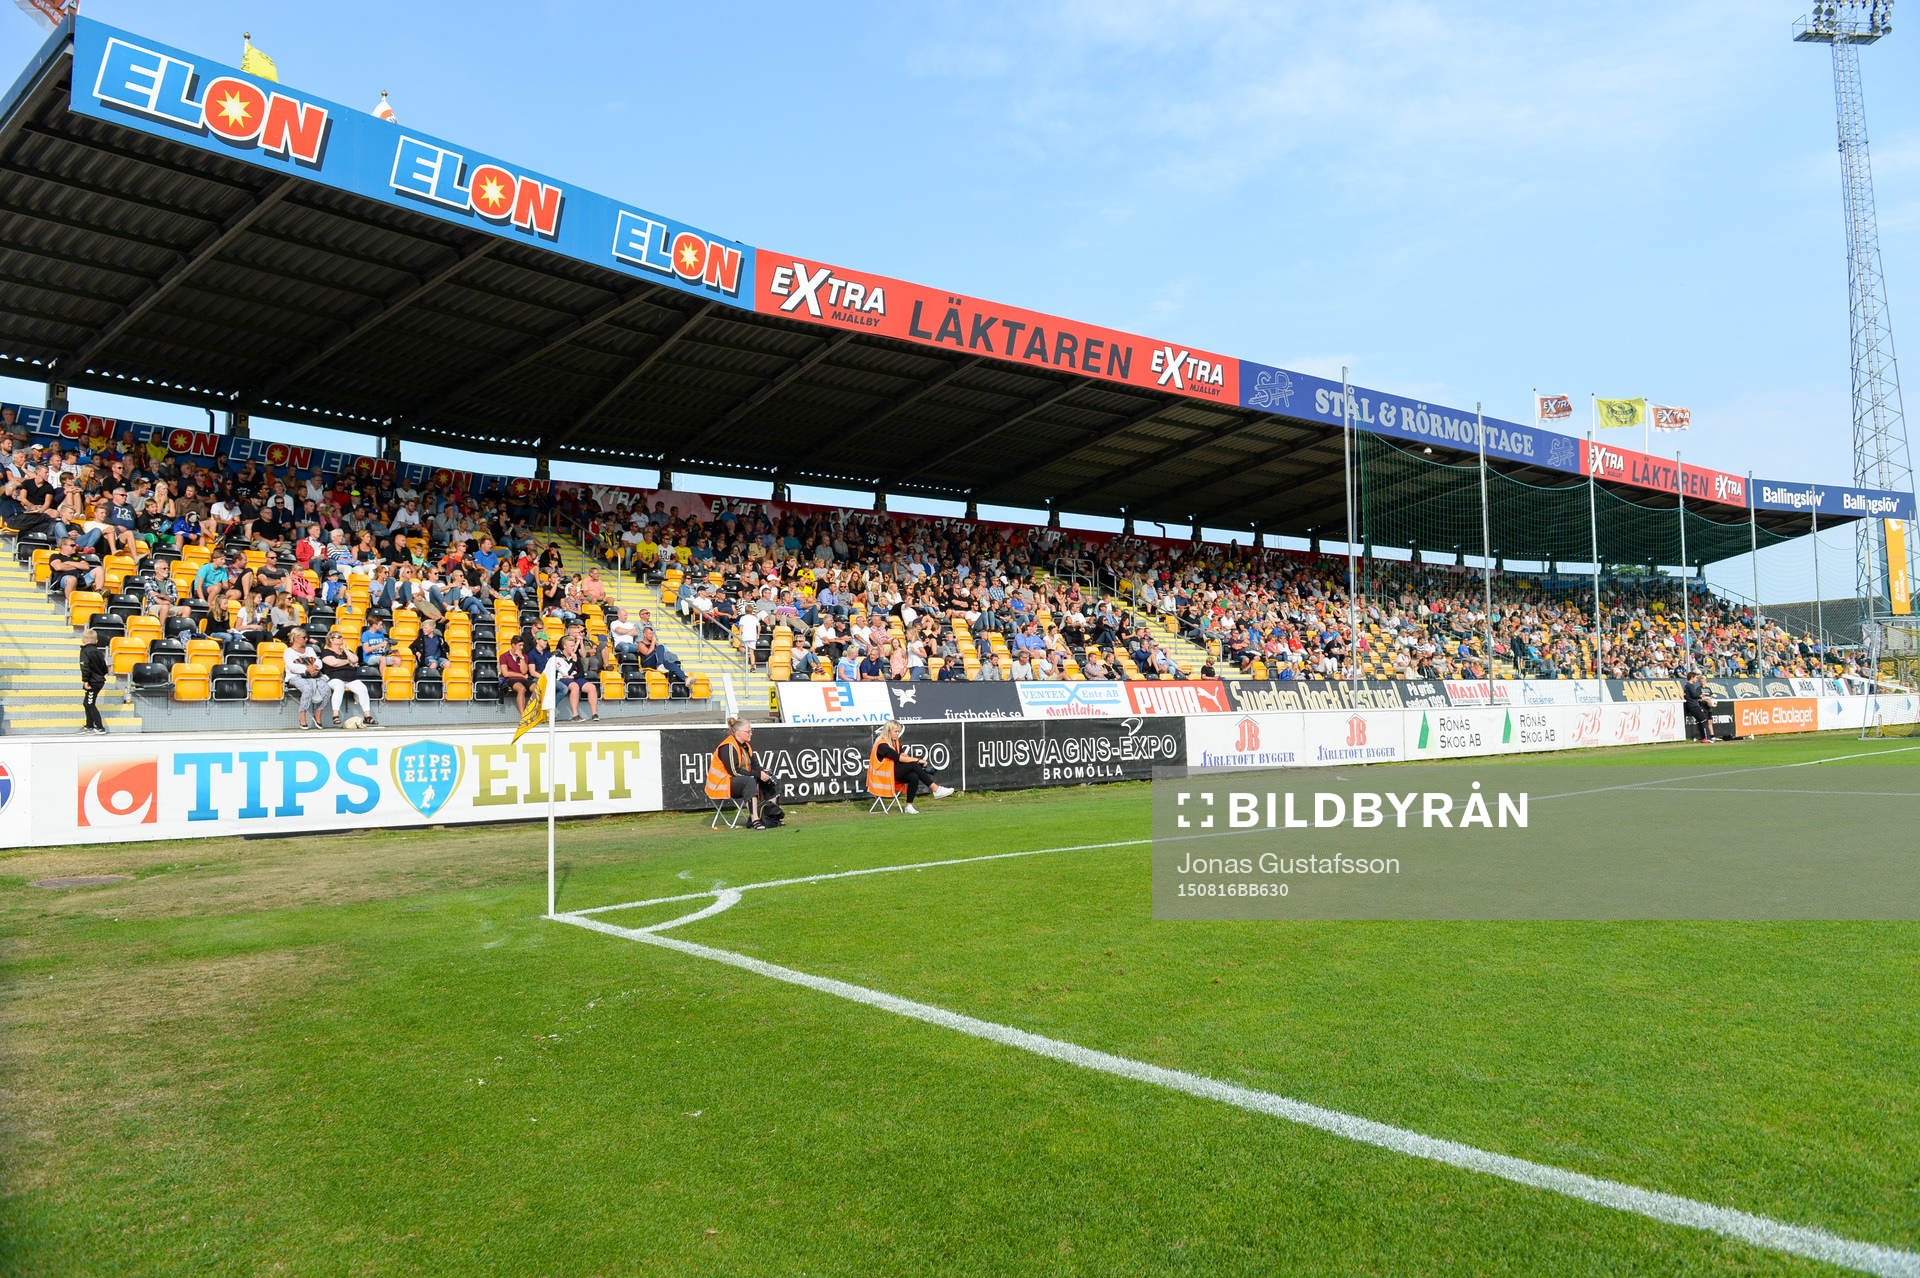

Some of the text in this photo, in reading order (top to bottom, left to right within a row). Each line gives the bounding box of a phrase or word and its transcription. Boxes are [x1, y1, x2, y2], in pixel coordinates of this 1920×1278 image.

[93, 36, 328, 163] ELON
[389, 135, 561, 235] ELON
[612, 210, 743, 292] ELON
[771, 262, 886, 317] EXTRA
[908, 297, 1133, 380] LÄKTAREN
[1150, 345, 1224, 389] EXTRA
[1315, 386, 1534, 457] STÅL & RÖRMONTAGE
[229, 437, 312, 470] ELON
[1632, 457, 1710, 497] LÄKTAREN
[1715, 475, 1742, 500] EXTRA
[1763, 487, 1824, 508] Ballingslöv
[1843, 493, 1900, 514] Ballingslöv
[1133, 686, 1201, 714] PUMA
[1230, 681, 1301, 712] Sweden
[1298, 681, 1343, 711] Rock
[1446, 683, 1478, 700] MAXI
[1742, 708, 1769, 726] Enkla
[1772, 706, 1813, 728] Elbolaget
[978, 735, 1177, 767] HUSVAGNS-EXPO
[1469, 733, 1482, 747] AB
[1545, 729, 1556, 742] AB
[404, 754, 451, 768] TIPS
[404, 768, 451, 782] ELIT
[471, 741, 640, 807] ELIT
[1044, 764, 1124, 780] BROMÖLLA
[173, 746, 380, 822] TIPS
[784, 778, 869, 798] ROMÖLL
